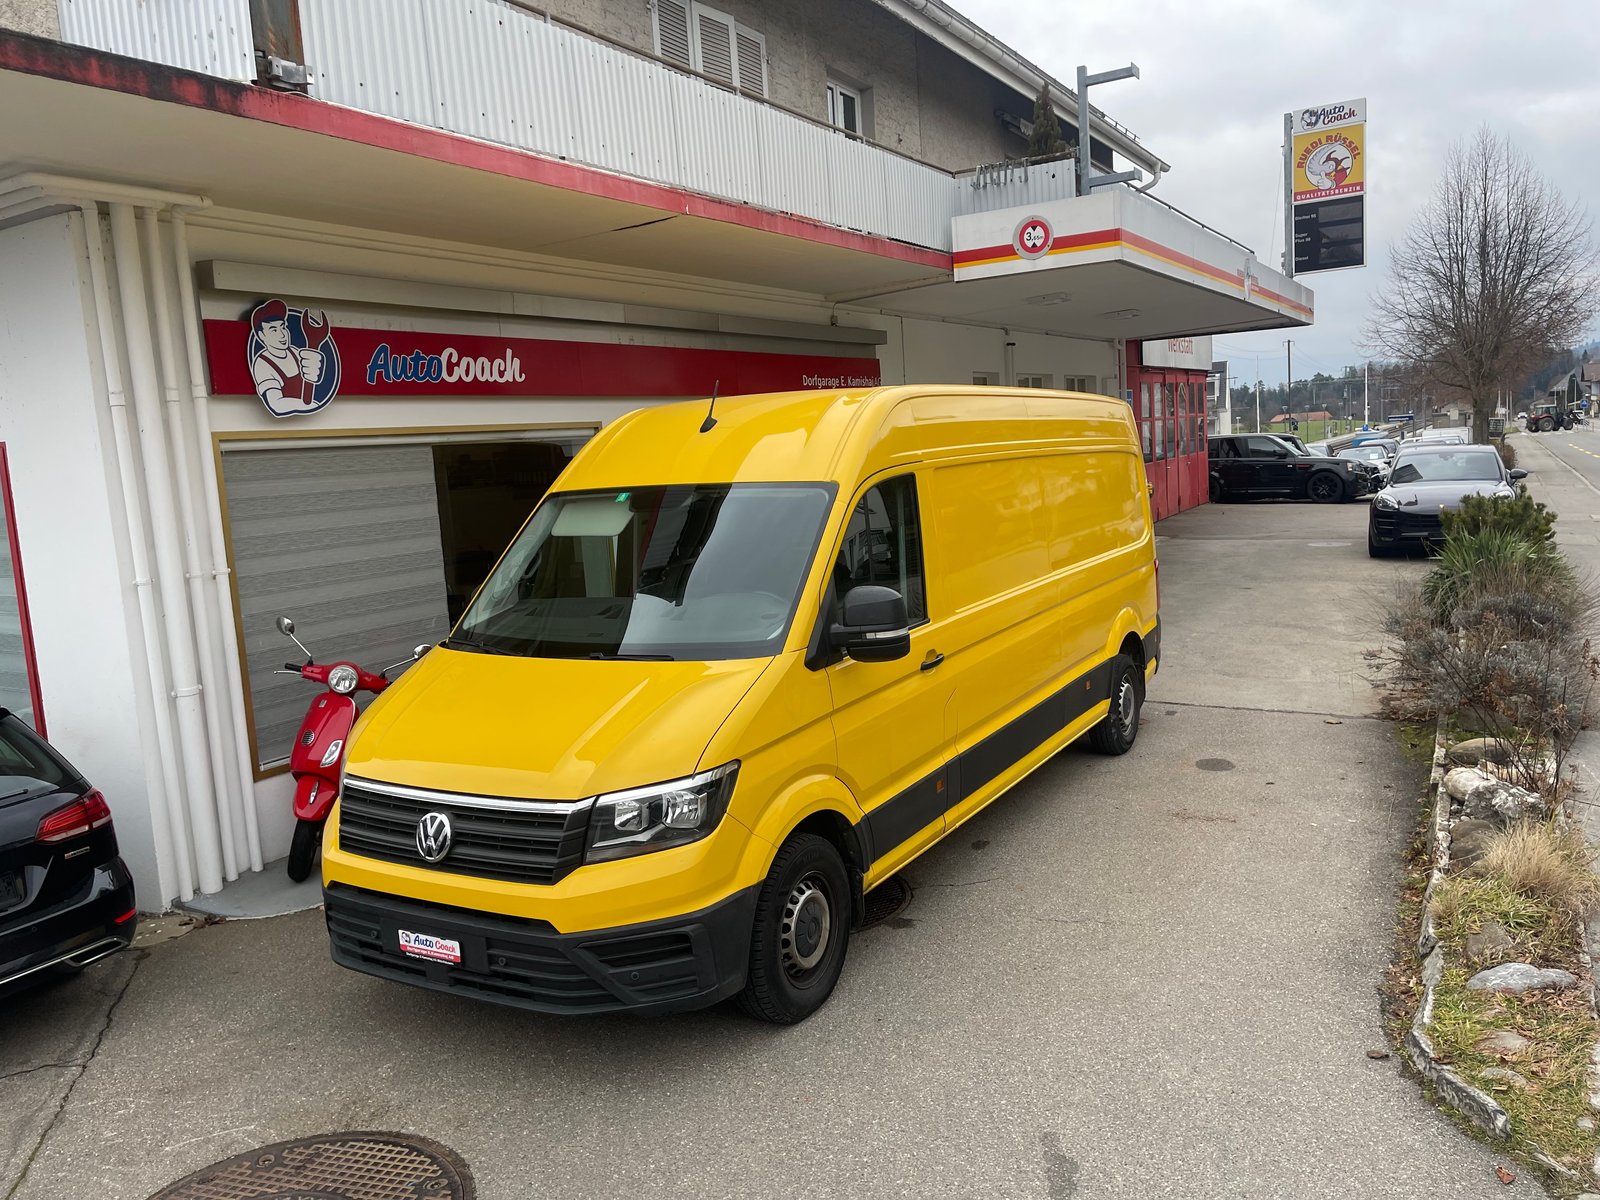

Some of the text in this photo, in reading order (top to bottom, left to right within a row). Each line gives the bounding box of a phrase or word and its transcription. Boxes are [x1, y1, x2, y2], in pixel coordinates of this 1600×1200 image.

[1319, 105, 1345, 119] Auto
[1322, 107, 1358, 126] Coach
[1296, 132, 1361, 169] RUEDI RÜSSEL
[802, 374, 840, 389] Dorfgarage
[840, 375, 847, 386] E.
[413, 934, 456, 953] Auto Coach
